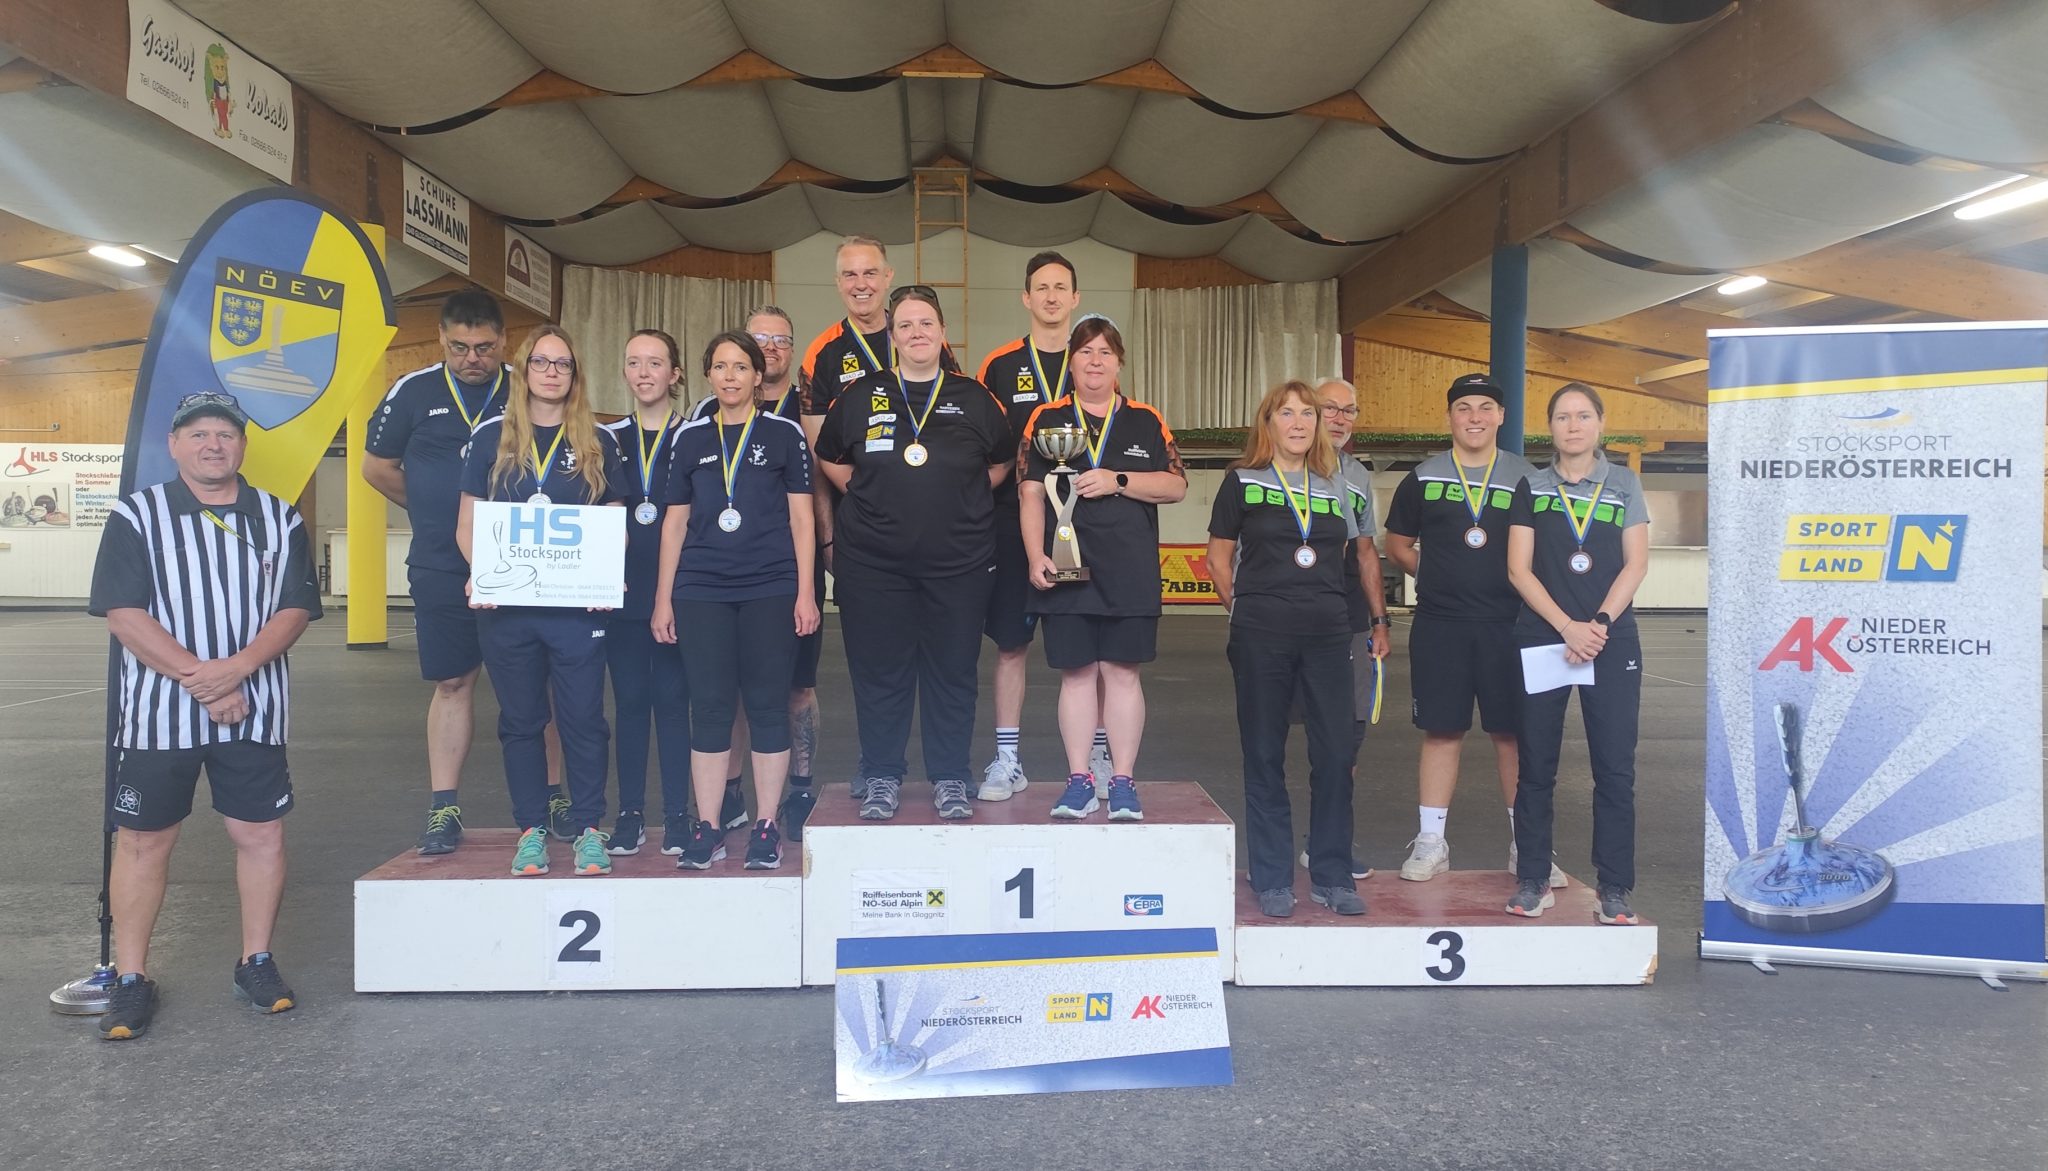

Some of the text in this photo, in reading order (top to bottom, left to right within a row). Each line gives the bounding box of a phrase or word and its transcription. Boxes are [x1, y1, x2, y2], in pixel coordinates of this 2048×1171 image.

[142, 14, 194, 82] Gasthof
[420, 176, 456, 211] SCHUHE
[406, 189, 468, 246] LASSMANN
[226, 266, 334, 300] NÖEV
[429, 407, 449, 416] JAKO
[1796, 435, 1952, 452] STOCKSPORT
[31, 451, 124, 465] HLS Stockspor
[699, 454, 718, 465] JAKO
[1740, 455, 2012, 479] NIEDERÖSTERREICH
[510, 507, 583, 546] HS
[1798, 522, 1878, 537] SPORT
[509, 545, 582, 561] Stocksport
[1799, 558, 1863, 573] LAND
[1161, 579, 1217, 592] FABB
[1861, 618, 1946, 635] NIEDER
[1757, 616, 1855, 673] AK
[1846, 635, 1992, 656] ÖSTERREICH
[863, 891, 922, 899] Raiffeisenbank
[1005, 868, 1034, 919] 1
[900, 899, 923, 908] Alpin
[558, 910, 601, 962] 2
[1425, 930, 1466, 982] 3
[942, 1006, 1000, 1016] STOCKSPORT
[1131, 995, 1166, 1019] AK
[1166, 994, 1197, 1002] NIEDER
[1161, 1001, 1213, 1010] ÖSTERREICH
[921, 1015, 1022, 1028] NIEDERÖSTERREICH
